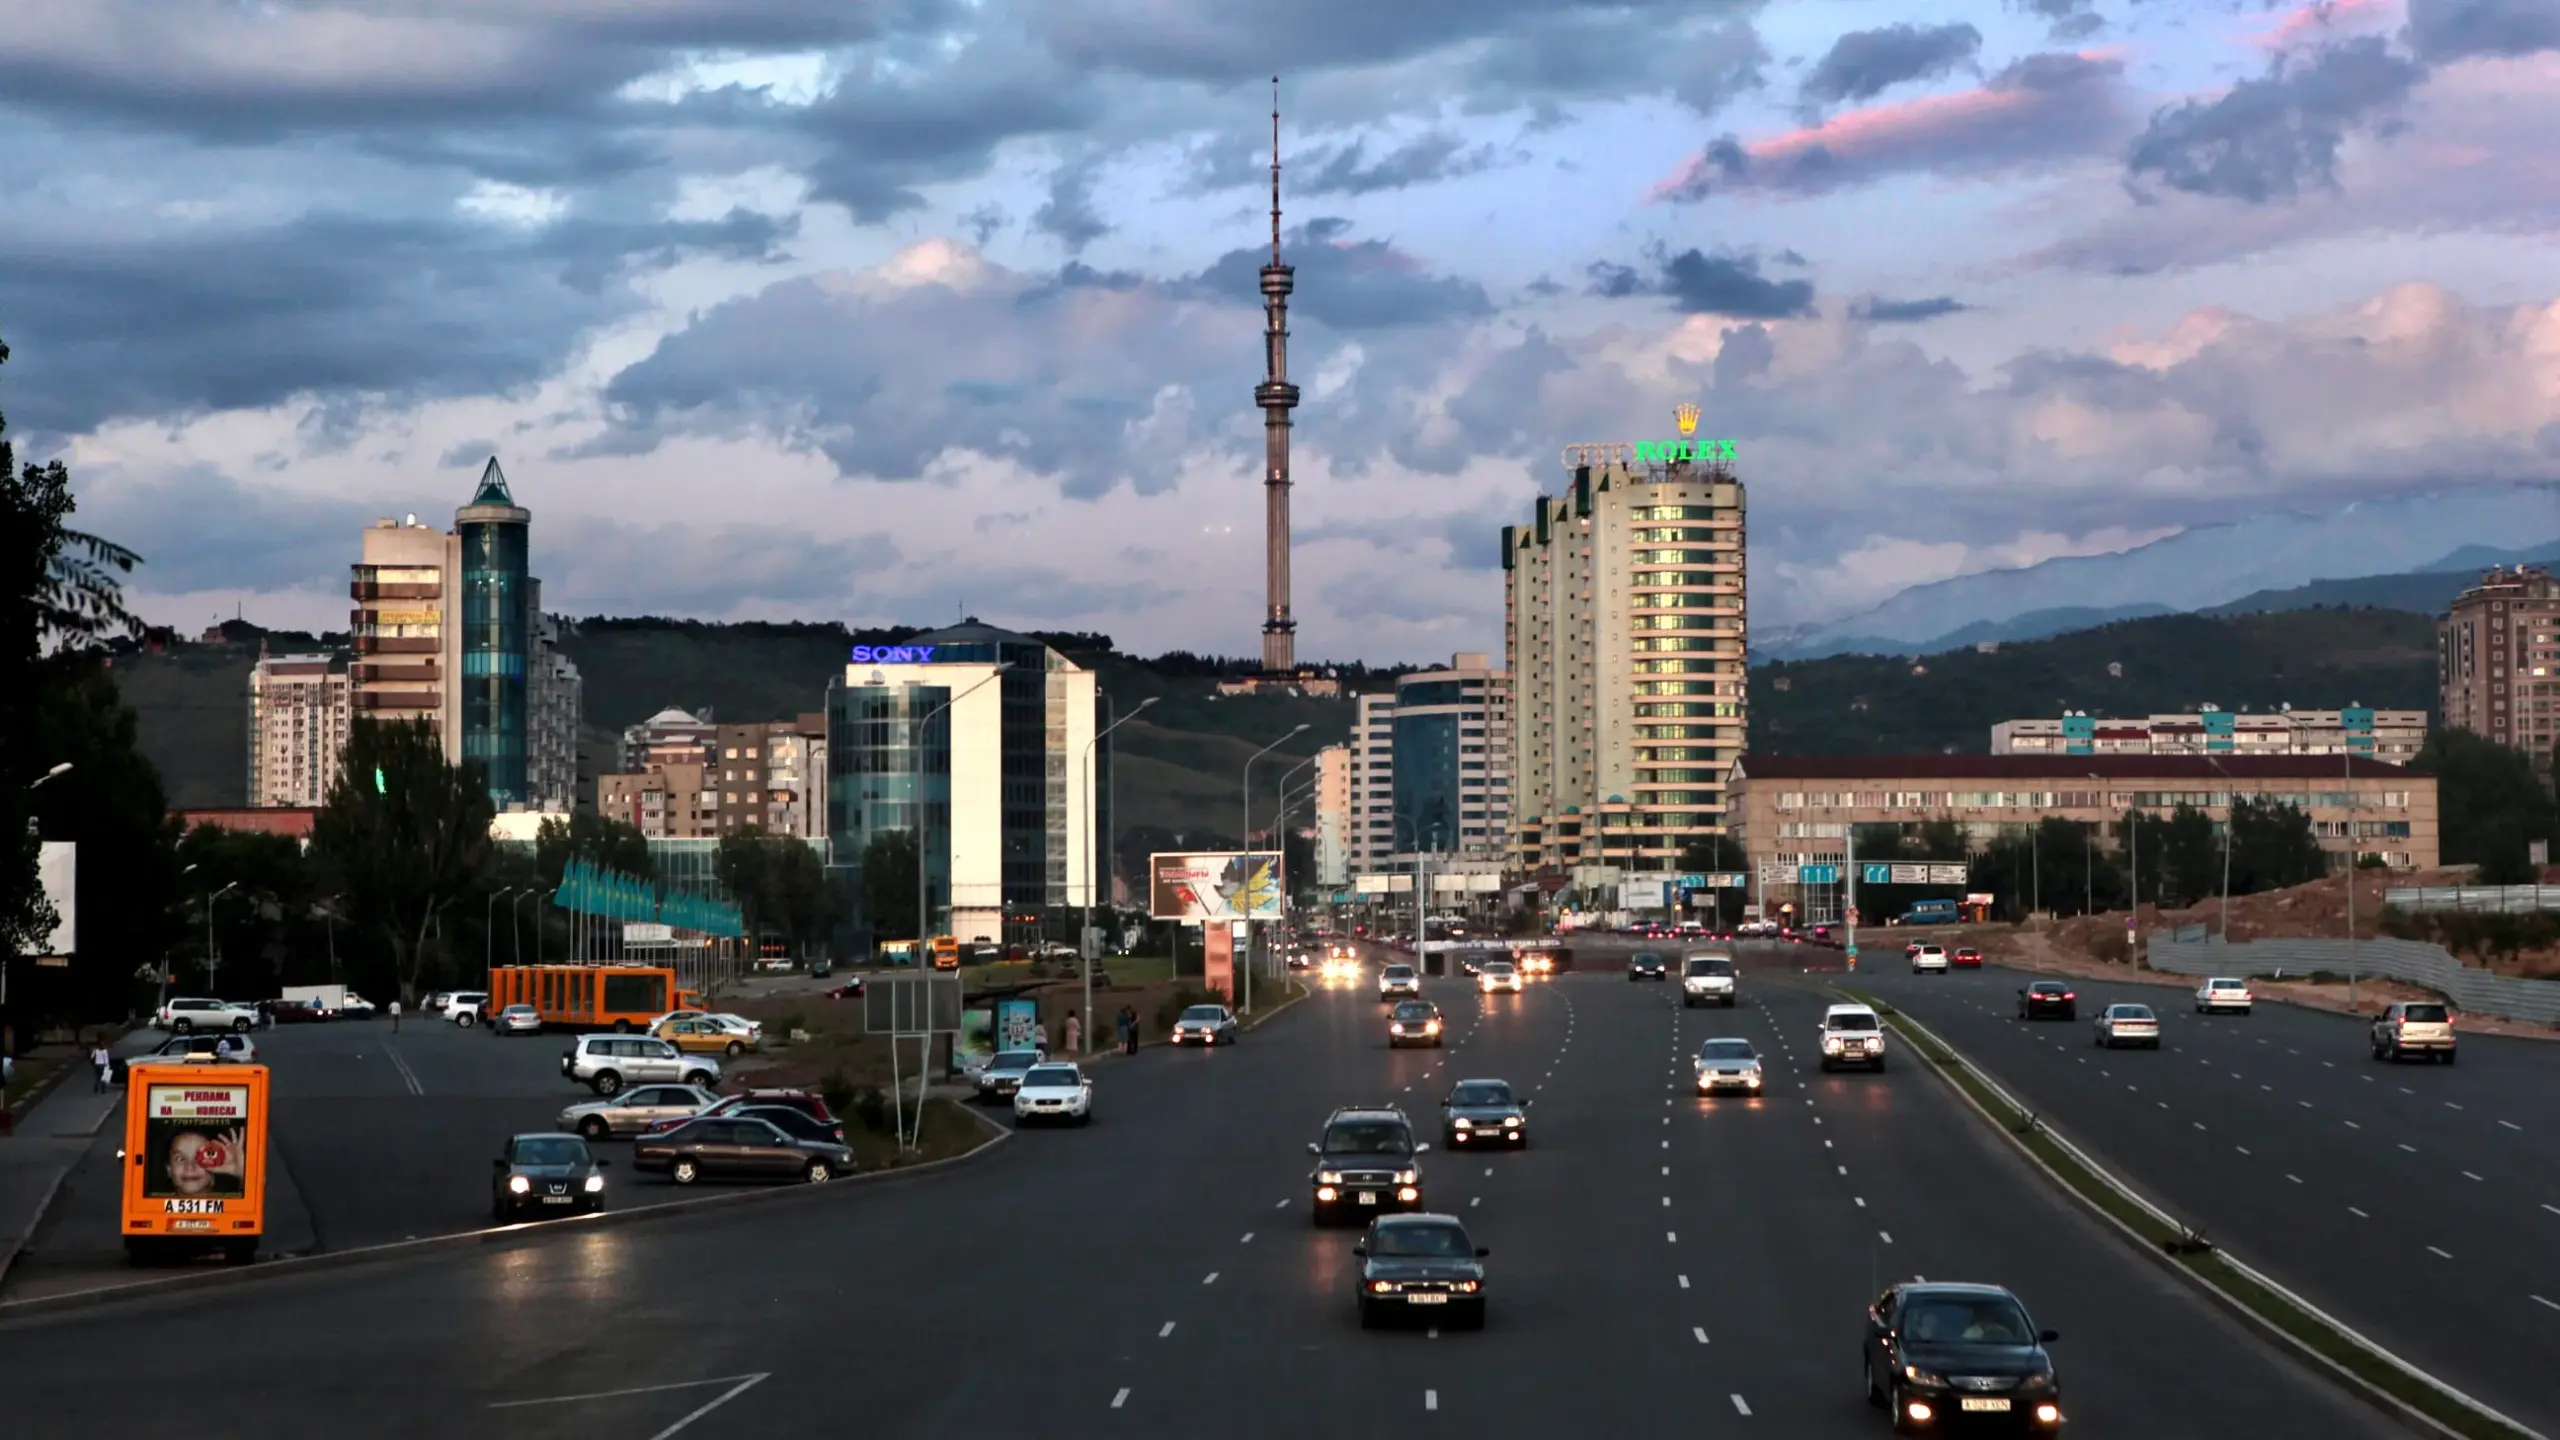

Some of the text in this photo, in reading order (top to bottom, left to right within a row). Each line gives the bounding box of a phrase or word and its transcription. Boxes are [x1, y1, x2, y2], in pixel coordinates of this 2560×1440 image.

[1635, 440, 1738, 461] ROLEX
[852, 645, 935, 662] SONY
[184, 1091, 231, 1102] РЕКЛАМА
[160, 1106, 172, 1115] НА
[178, 1200, 201, 1213] 531
[206, 1200, 224, 1213] FM
